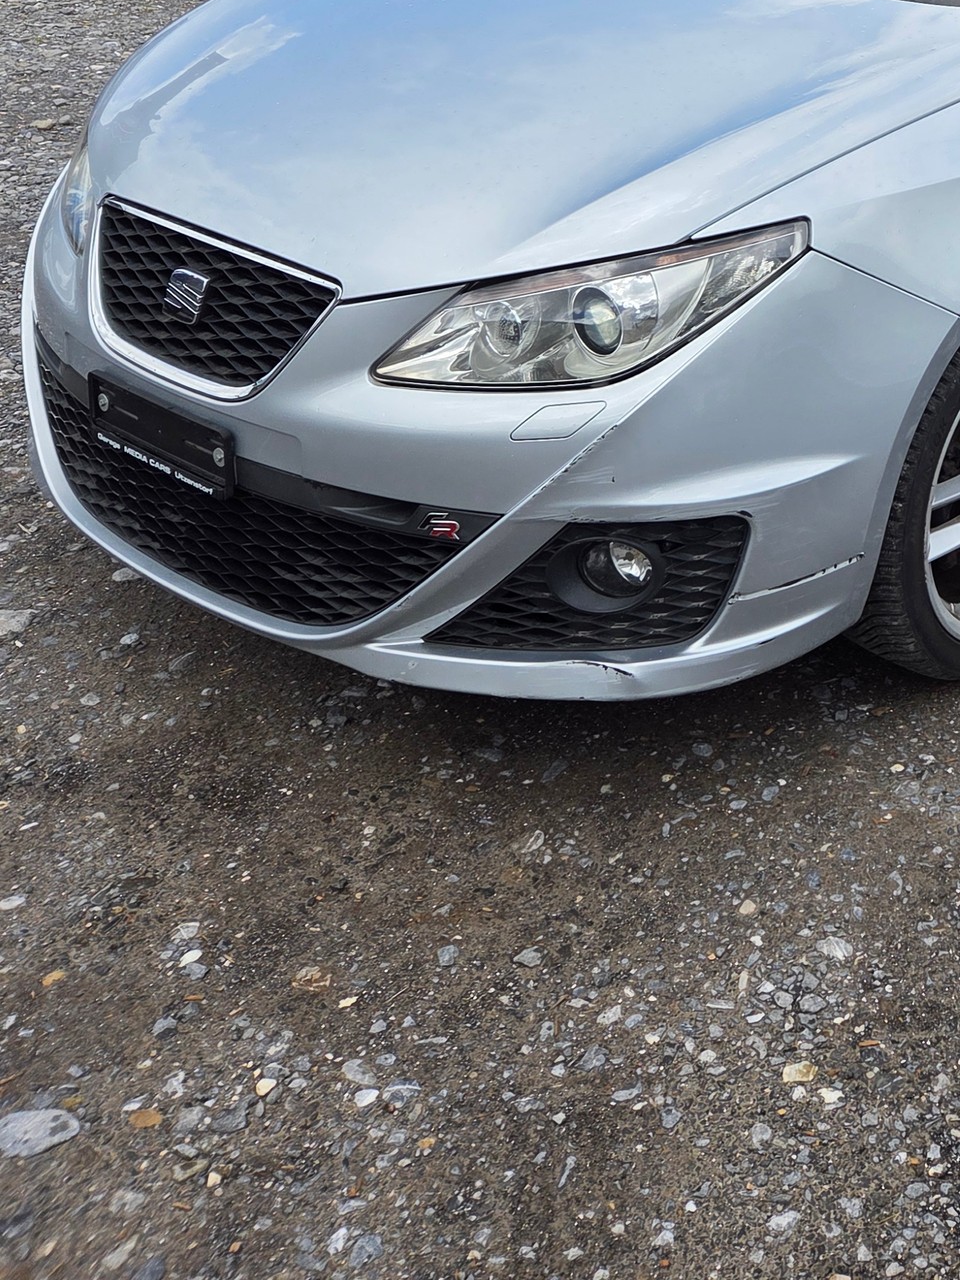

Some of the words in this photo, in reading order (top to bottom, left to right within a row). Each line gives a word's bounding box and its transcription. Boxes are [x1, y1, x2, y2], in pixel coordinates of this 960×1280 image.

[124, 445, 148, 463] MEDIA
[149, 458, 171, 475] CARS
[417, 512, 460, 540] FR
